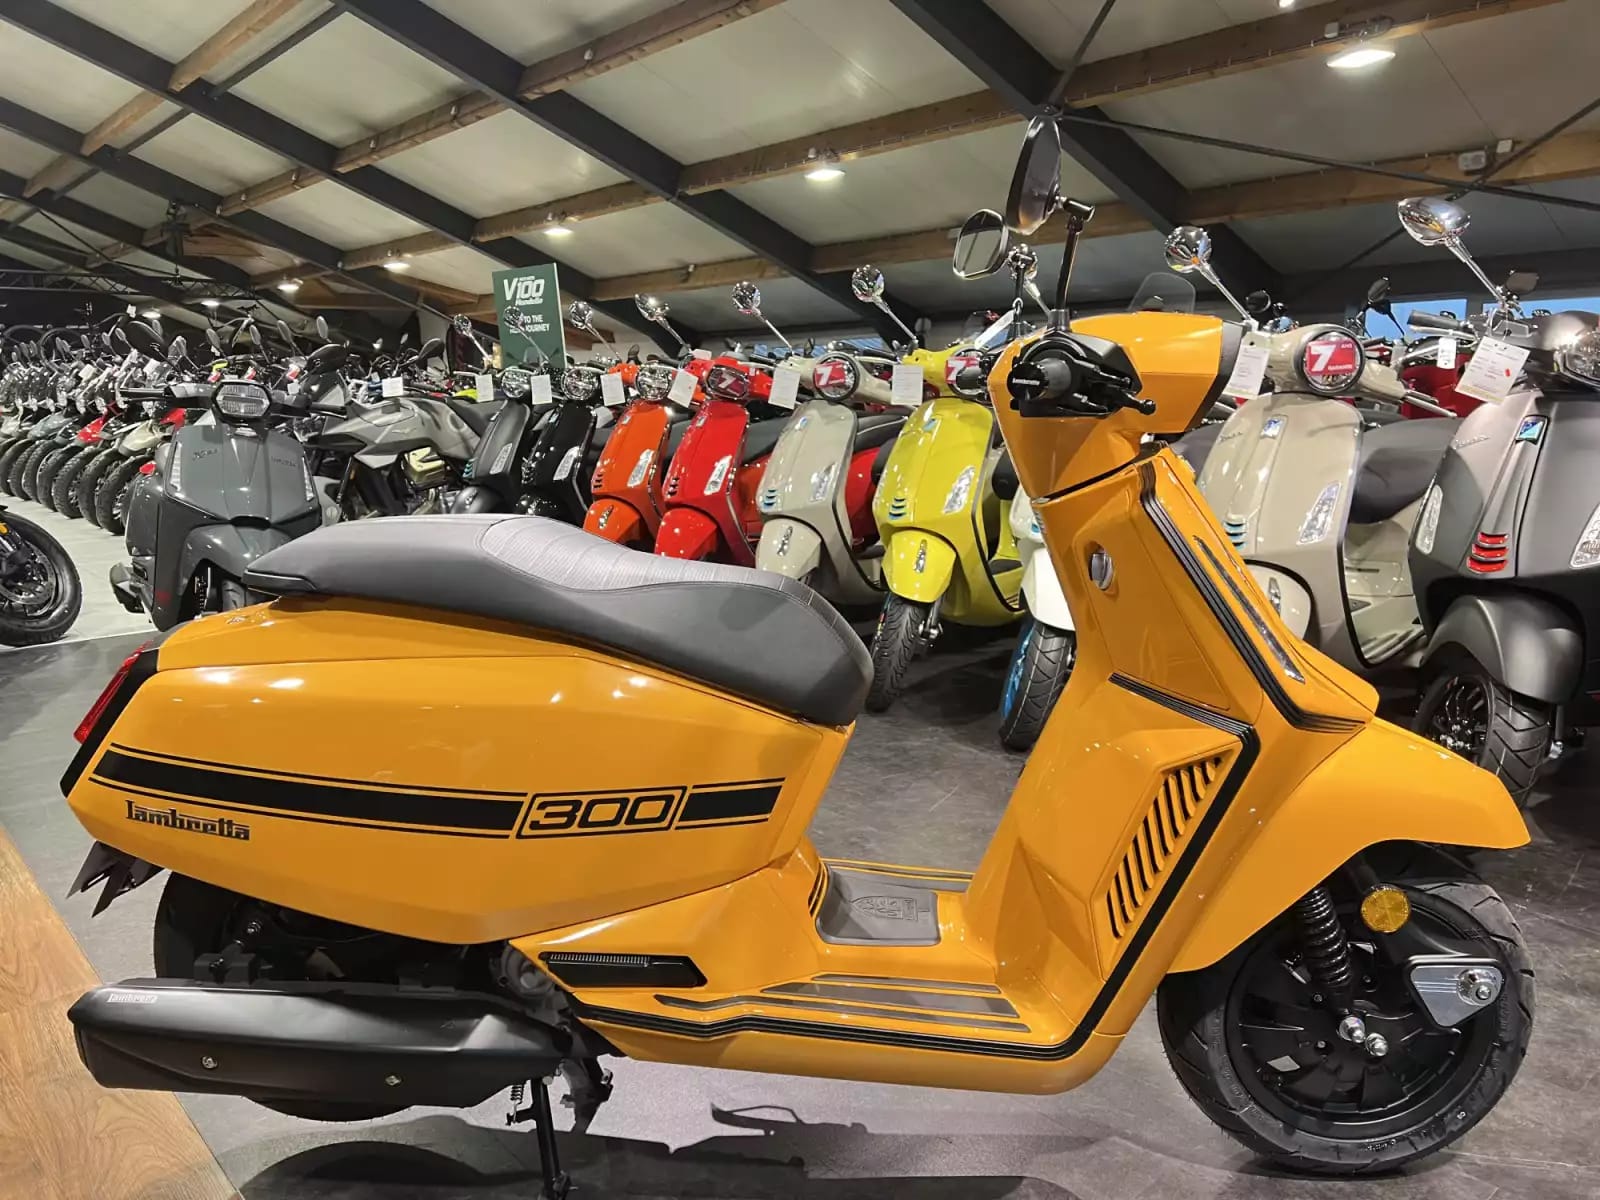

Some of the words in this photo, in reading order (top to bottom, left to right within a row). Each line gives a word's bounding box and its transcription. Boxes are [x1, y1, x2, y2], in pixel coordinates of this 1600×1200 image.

[531, 314, 544, 323] THE
[1310, 344, 1336, 372] 7
[718, 372, 737, 389] 7
[816, 366, 833, 386] 7
[529, 794, 675, 831] 300
